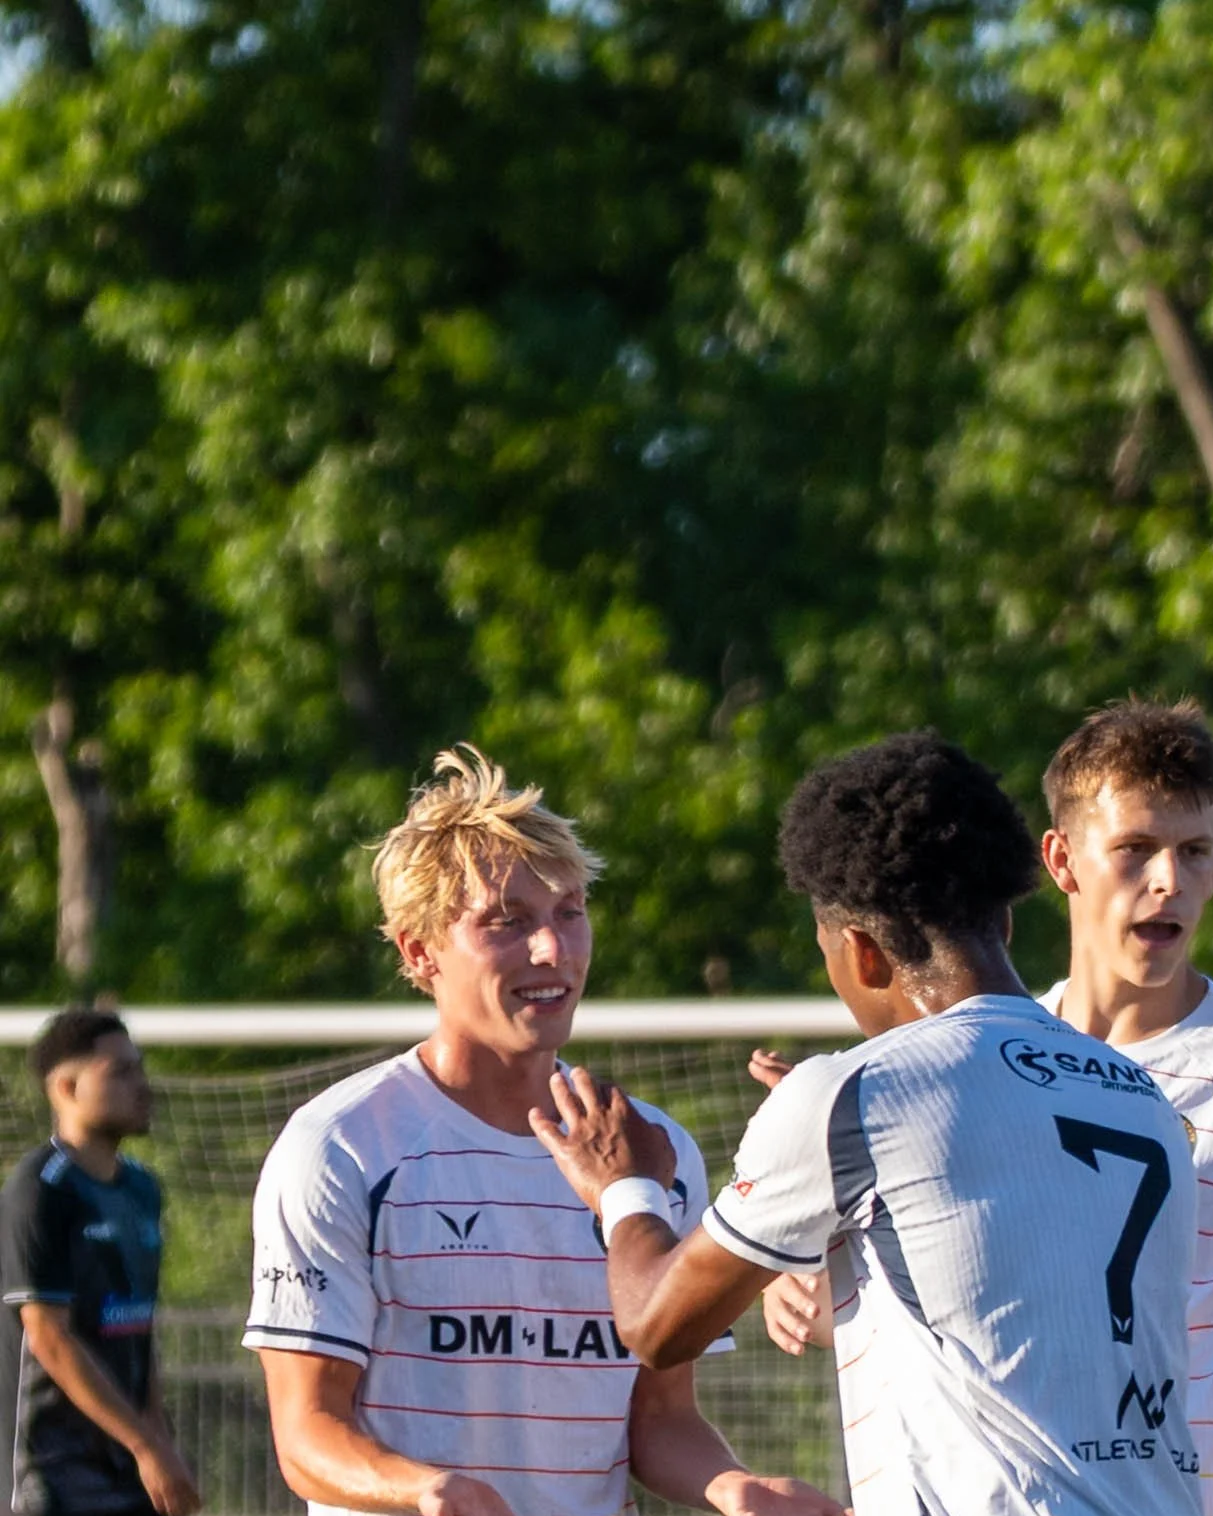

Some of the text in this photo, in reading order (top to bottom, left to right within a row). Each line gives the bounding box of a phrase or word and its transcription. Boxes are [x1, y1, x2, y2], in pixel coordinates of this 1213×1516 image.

[1053, 1053, 1155, 1089] SANO
[1053, 1115, 1171, 1345] 7
[429, 1314, 513, 1354] DM
